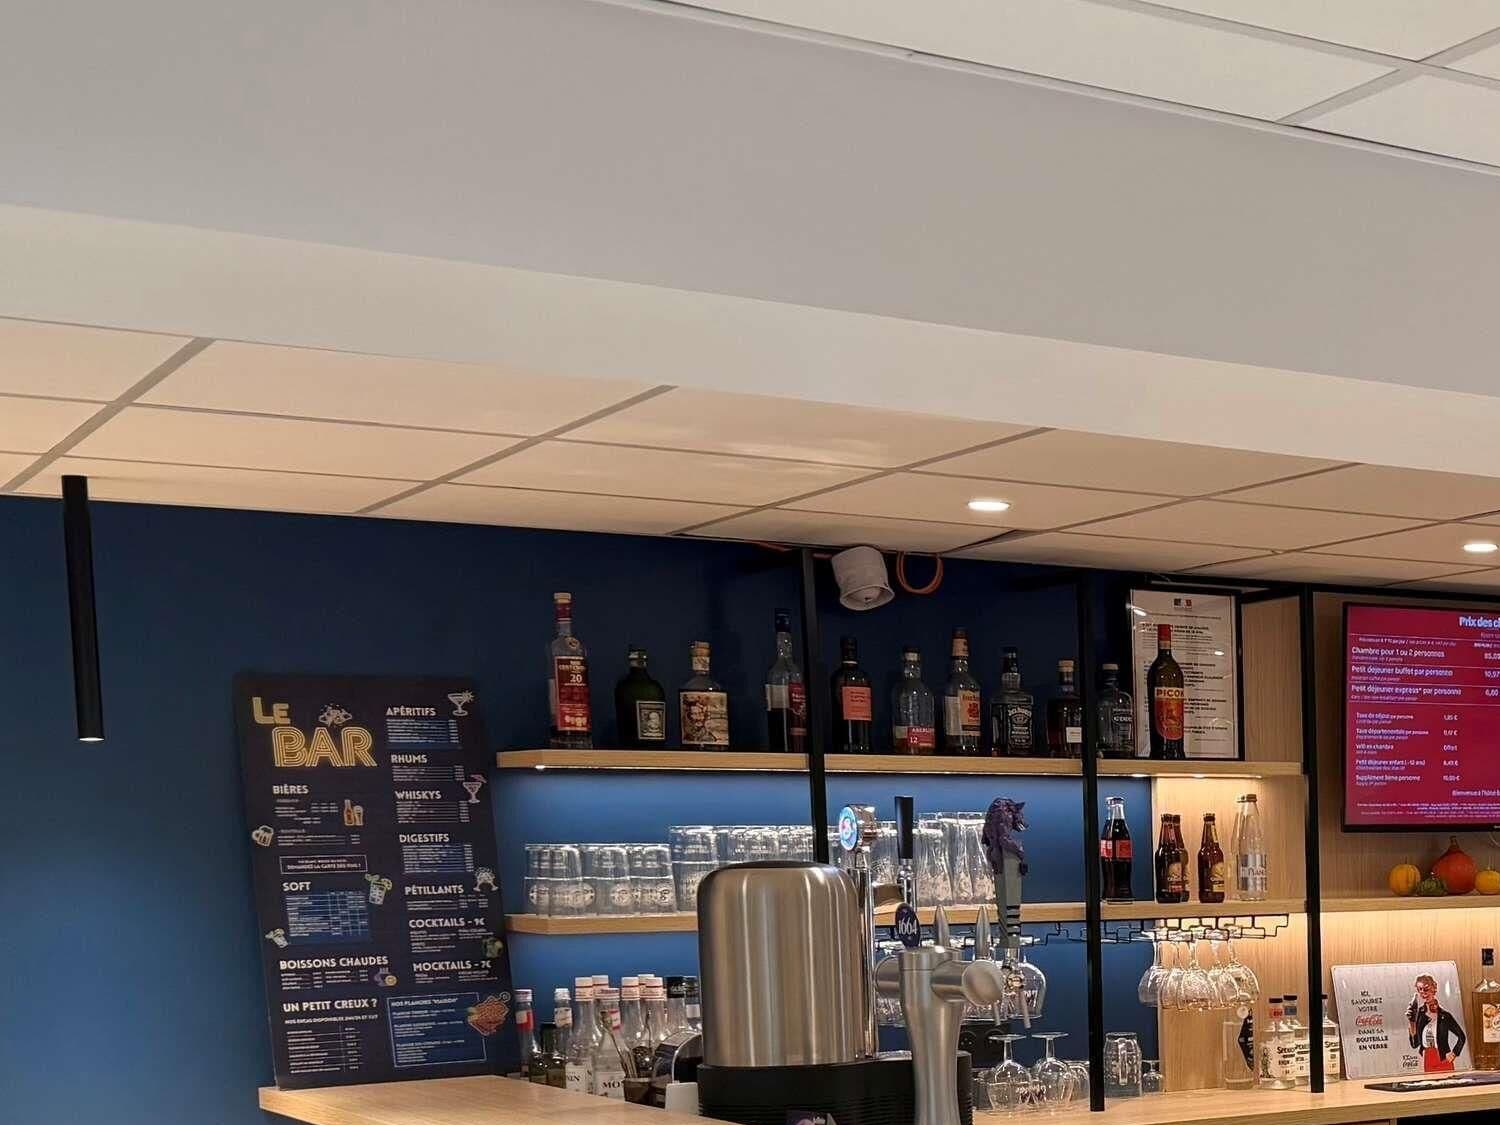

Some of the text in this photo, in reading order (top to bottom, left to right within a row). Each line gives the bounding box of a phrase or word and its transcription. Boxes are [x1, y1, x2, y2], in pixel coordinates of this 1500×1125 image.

[1459, 616, 1476, 627] Prix
[1477, 617, 1492, 628] des
[1380, 649, 1394, 657] pour
[1414, 650, 1445, 658] personnes
[570, 674, 582, 683] 20
[386, 705, 436, 716] APÉRITIFS
[271, 726, 378, 767] BAR
[391, 755, 428, 764] RHUMS
[272, 784, 309, 795] BIÈRES
[395, 790, 441, 800] WHISKYS
[399, 833, 450, 843] DIGESTIFS
[282, 881, 311, 892] SOFT
[405, 884, 464, 896] PÉTILLANTS
[408, 918, 466, 928] COCKTAILS
[898, 917, 917, 935] 1664
[280, 956, 389, 970] BOISSONS CHAUDES
[413, 960, 472, 972] MOCKTAILS
[283, 998, 378, 1012] UN PETIT CREUX ?
[1351, 997, 1383, 1005] SAVOUREZ
